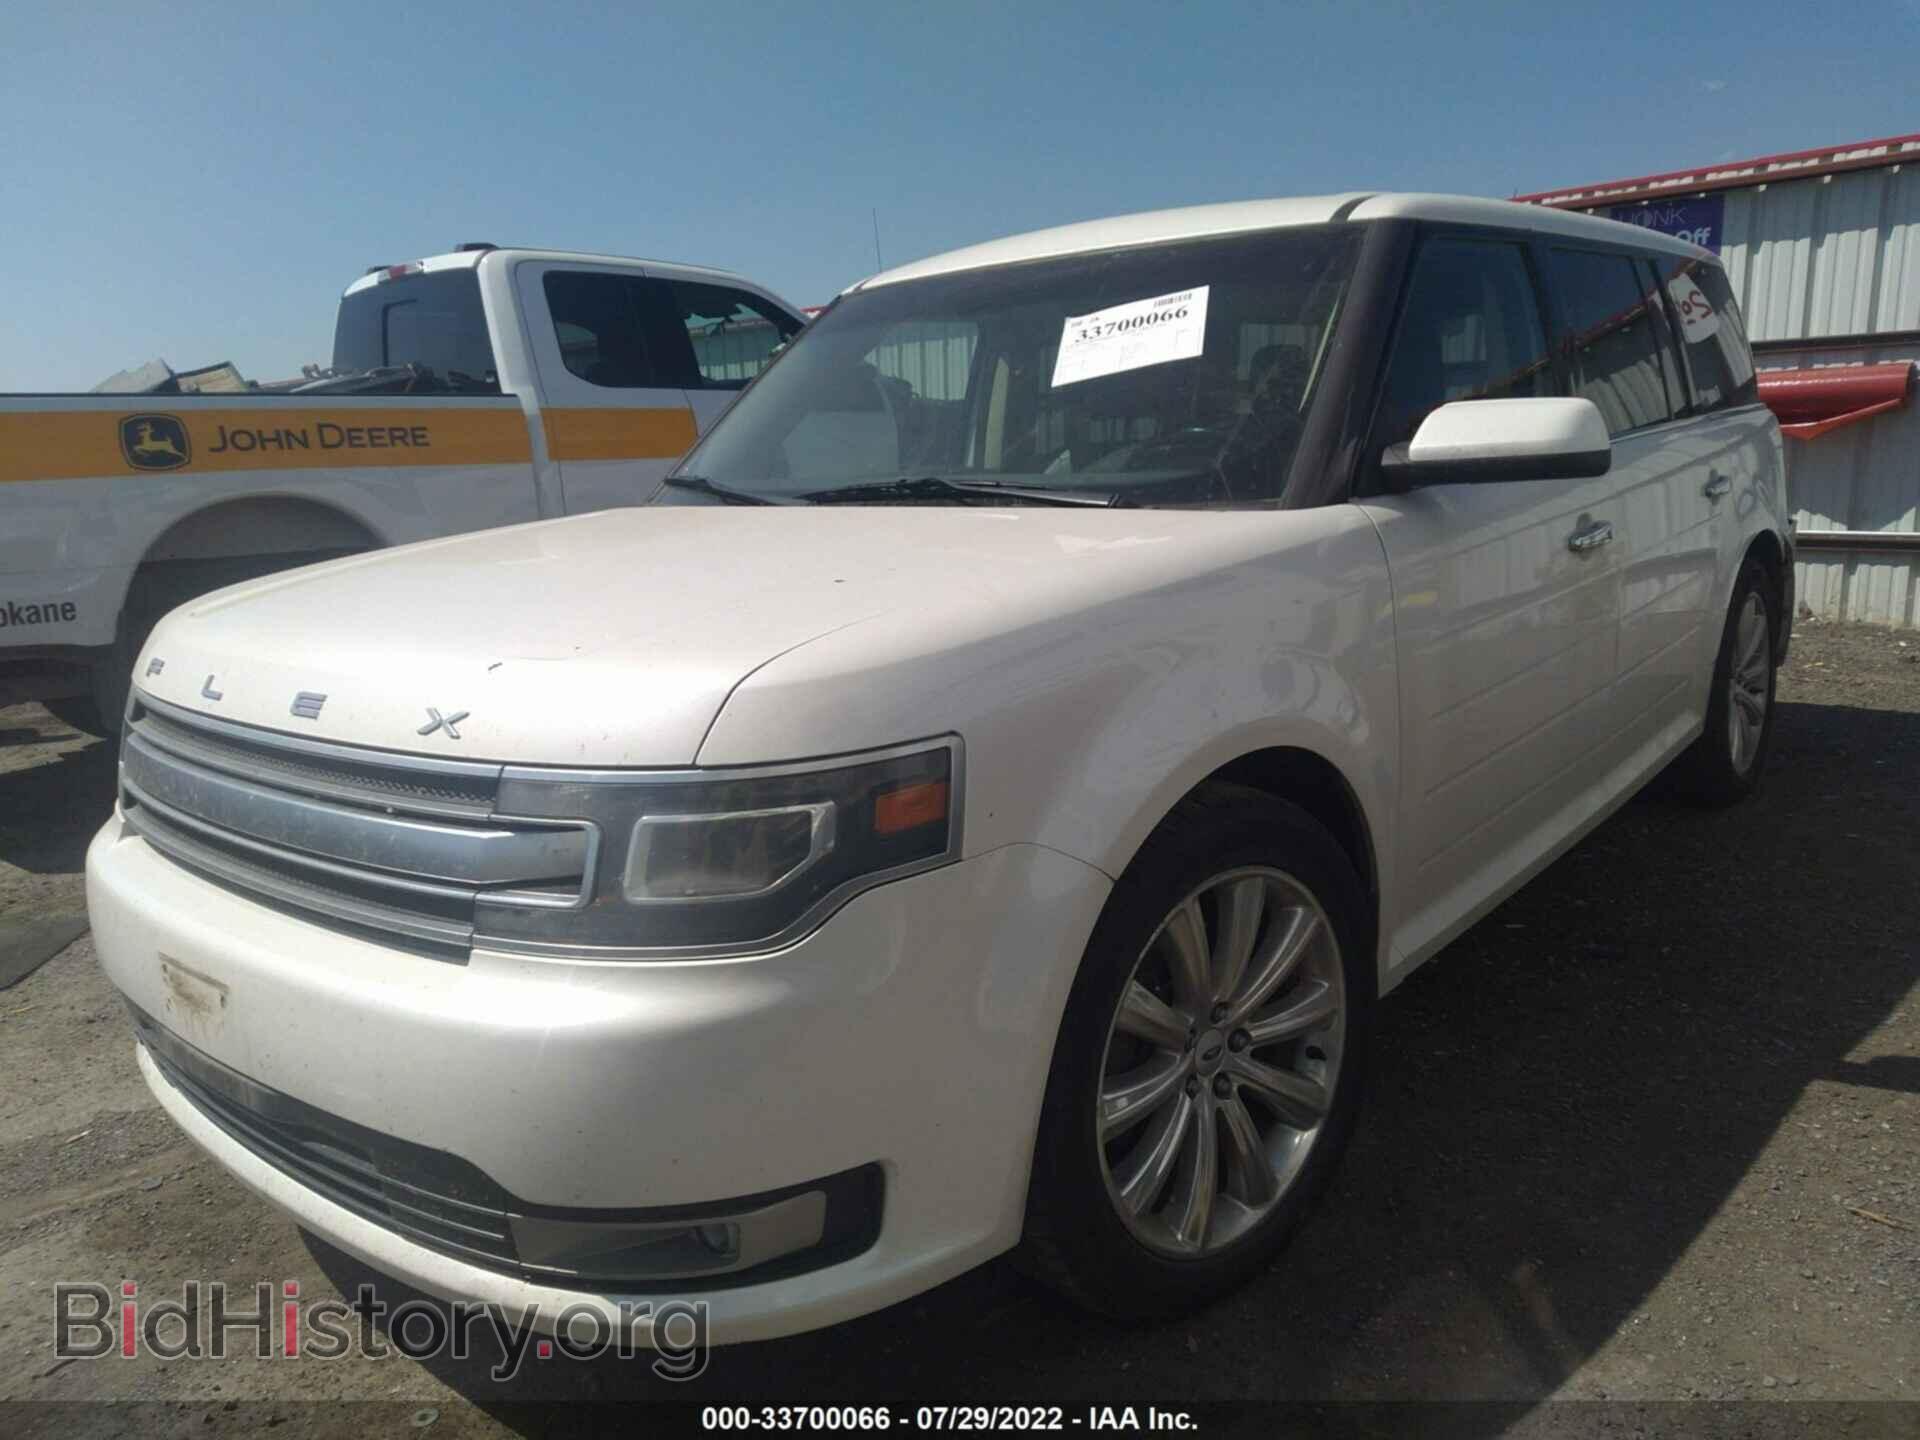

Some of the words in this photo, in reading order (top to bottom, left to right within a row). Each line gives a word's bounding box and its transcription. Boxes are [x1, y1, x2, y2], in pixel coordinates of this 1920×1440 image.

[1074, 305, 1189, 343] 33700066
[208, 425, 310, 453] JOHN
[316, 422, 431, 449] DEERE
[146, 657, 470, 740] FLEX
